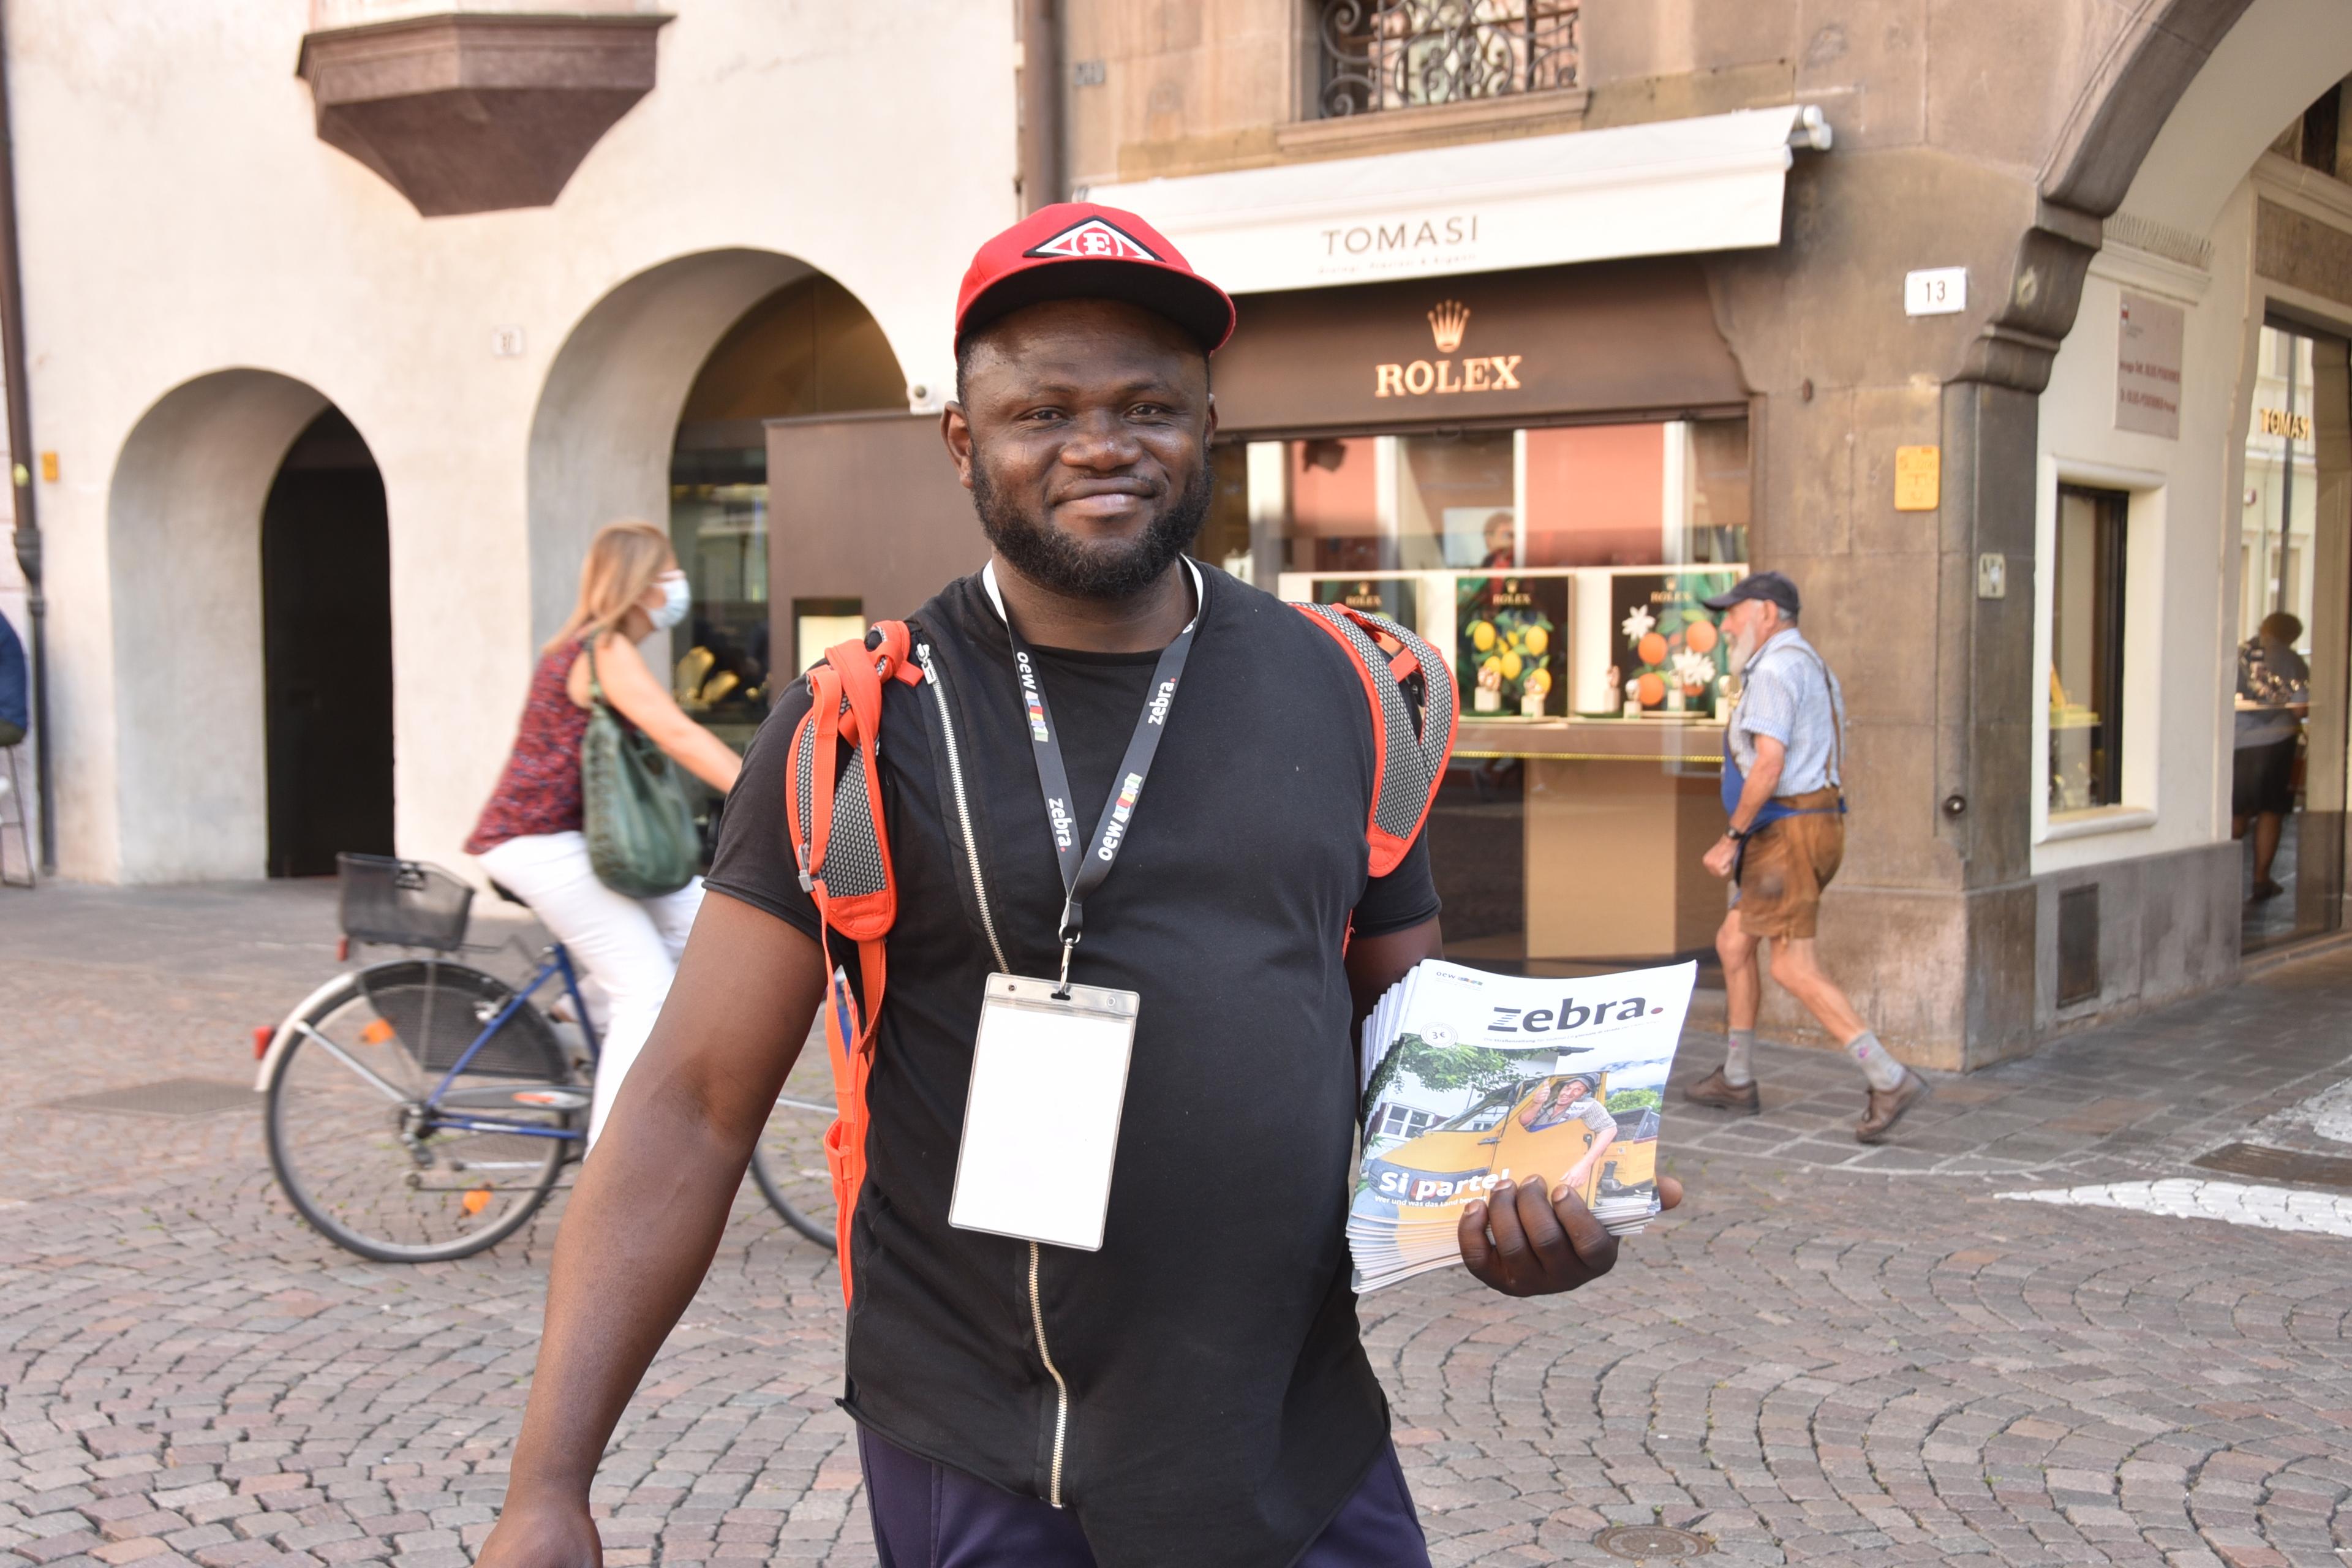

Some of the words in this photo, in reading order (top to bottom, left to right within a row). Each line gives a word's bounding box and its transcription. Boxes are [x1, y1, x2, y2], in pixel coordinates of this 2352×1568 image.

[1321, 215, 1478, 255] TOMASI
[1926, 280, 1946, 303] 13
[1374, 355, 1523, 398] ROLEX
[2259, 407, 2312, 442] TOMASI
[1492, 592, 1532, 606] ROLEX
[1017, 651, 1037, 690] oew
[1098, 820, 1124, 861] oew
[1374, 1195, 1390, 1204] Wer
[1379, 1171, 1410, 1194] Si
